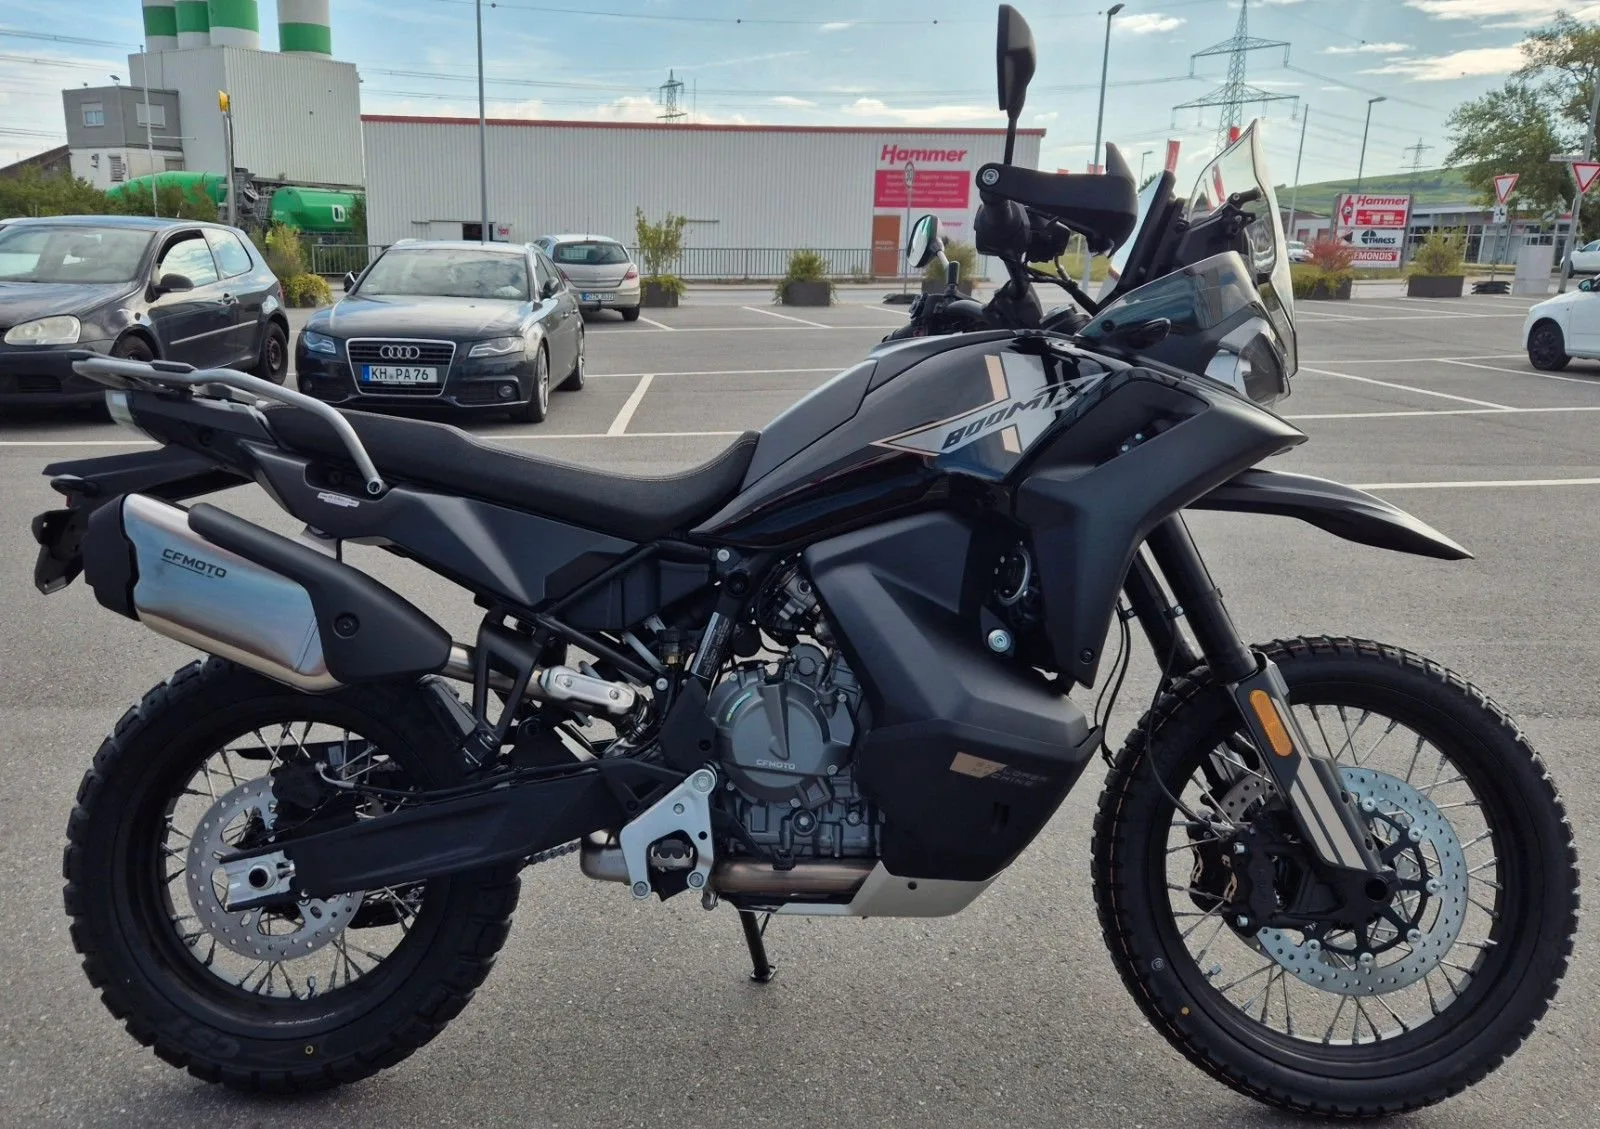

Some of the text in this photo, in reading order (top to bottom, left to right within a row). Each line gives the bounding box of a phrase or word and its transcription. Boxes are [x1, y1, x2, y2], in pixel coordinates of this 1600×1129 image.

[881, 144, 967, 165] Hammer
[1356, 195, 1408, 206] Hammer
[371, 367, 429, 381] KH PA 76
[162, 548, 227, 578] CFMOTO
[756, 759, 796, 770] CFMOTO
